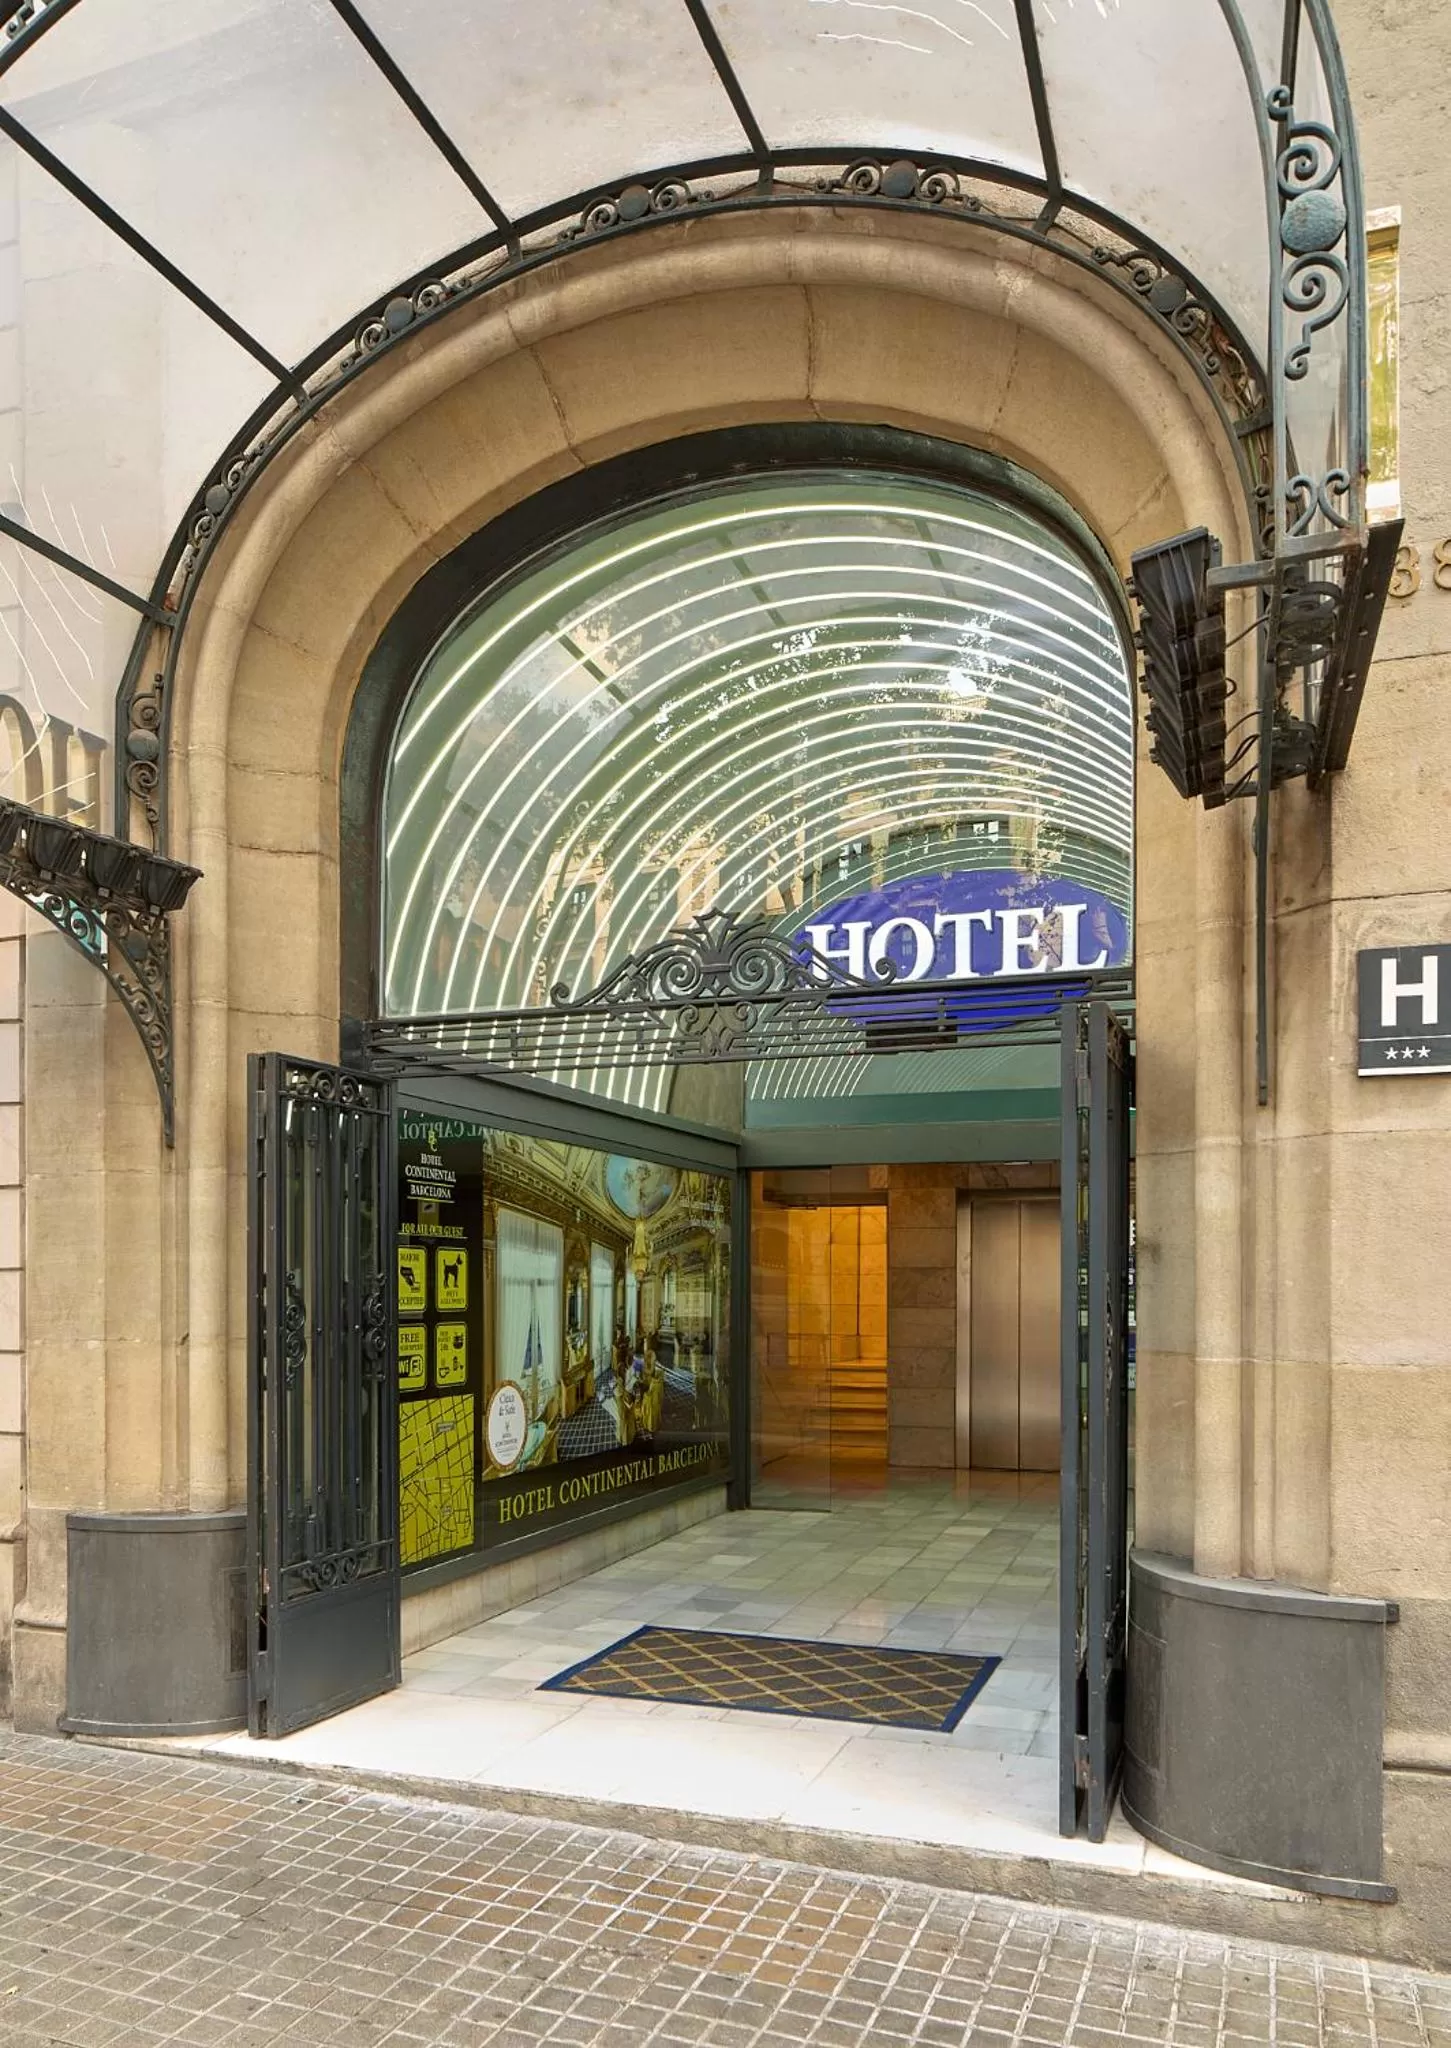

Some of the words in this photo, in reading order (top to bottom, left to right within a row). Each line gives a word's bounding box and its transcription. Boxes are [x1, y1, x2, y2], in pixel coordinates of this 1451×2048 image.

[804, 903, 1108, 988] HOTEL
[1381, 955, 1438, 1027] H
[421, 1154, 443, 1166] HOTEL
[405, 1164, 456, 1182] CONTINENTAL
[410, 1185, 451, 1198] BARCELONA
[400, 1332, 420, 1342] FREE
[498, 1485, 555, 1524] HOTEL
[559, 1457, 656, 1505] CONTINENTAL
[658, 1440, 721, 1474] BARCELONA
